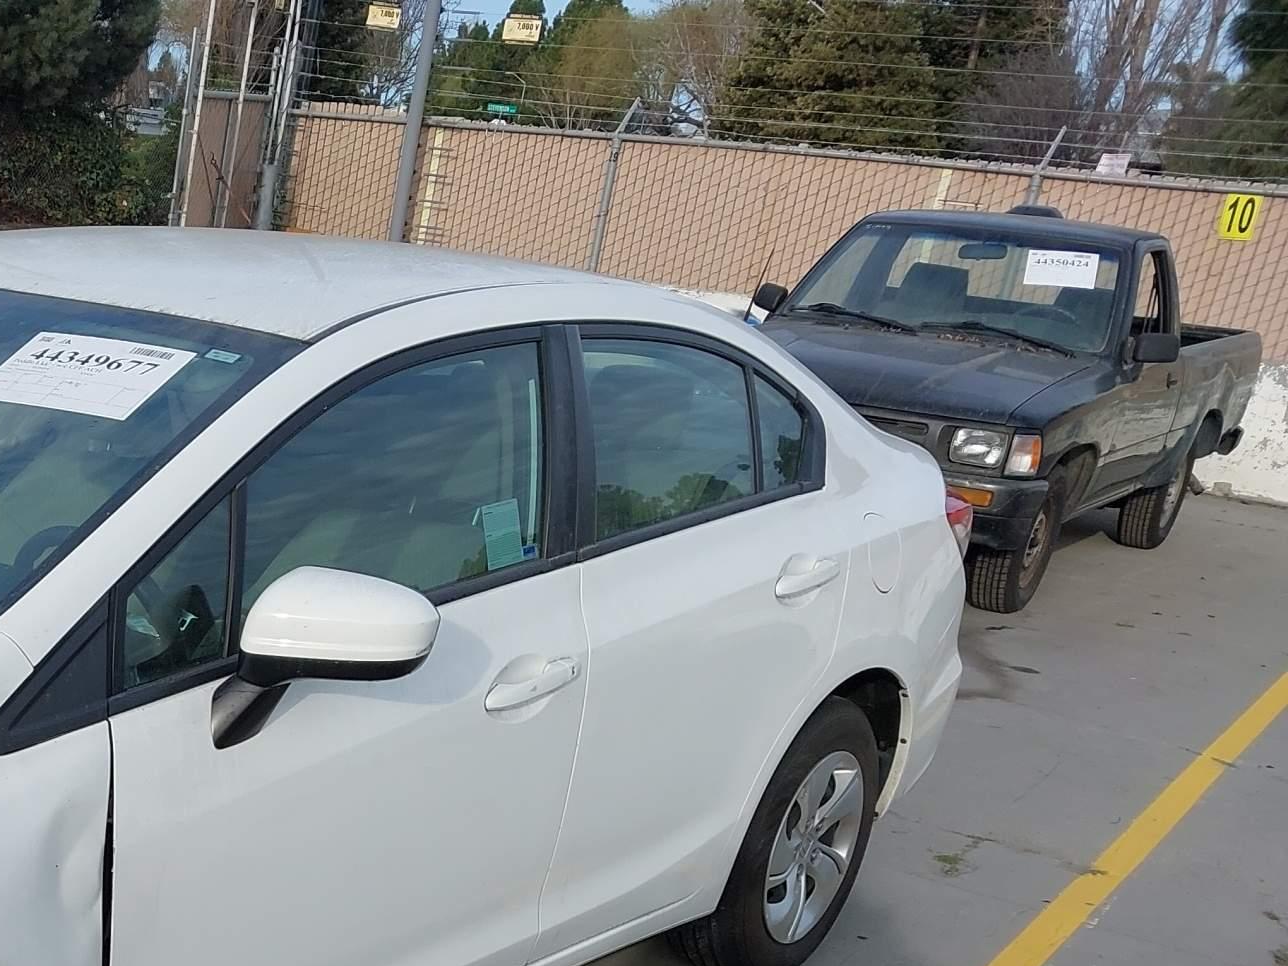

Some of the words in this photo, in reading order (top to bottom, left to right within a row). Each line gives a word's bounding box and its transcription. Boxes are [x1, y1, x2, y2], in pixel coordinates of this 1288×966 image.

[517, 22, 534, 31] 7,000
[535, 23, 540, 31] V
[1226, 196, 1256, 233] 10
[1033, 258, 1089, 267] 44350424
[30, 348, 160, 376] 44349677
